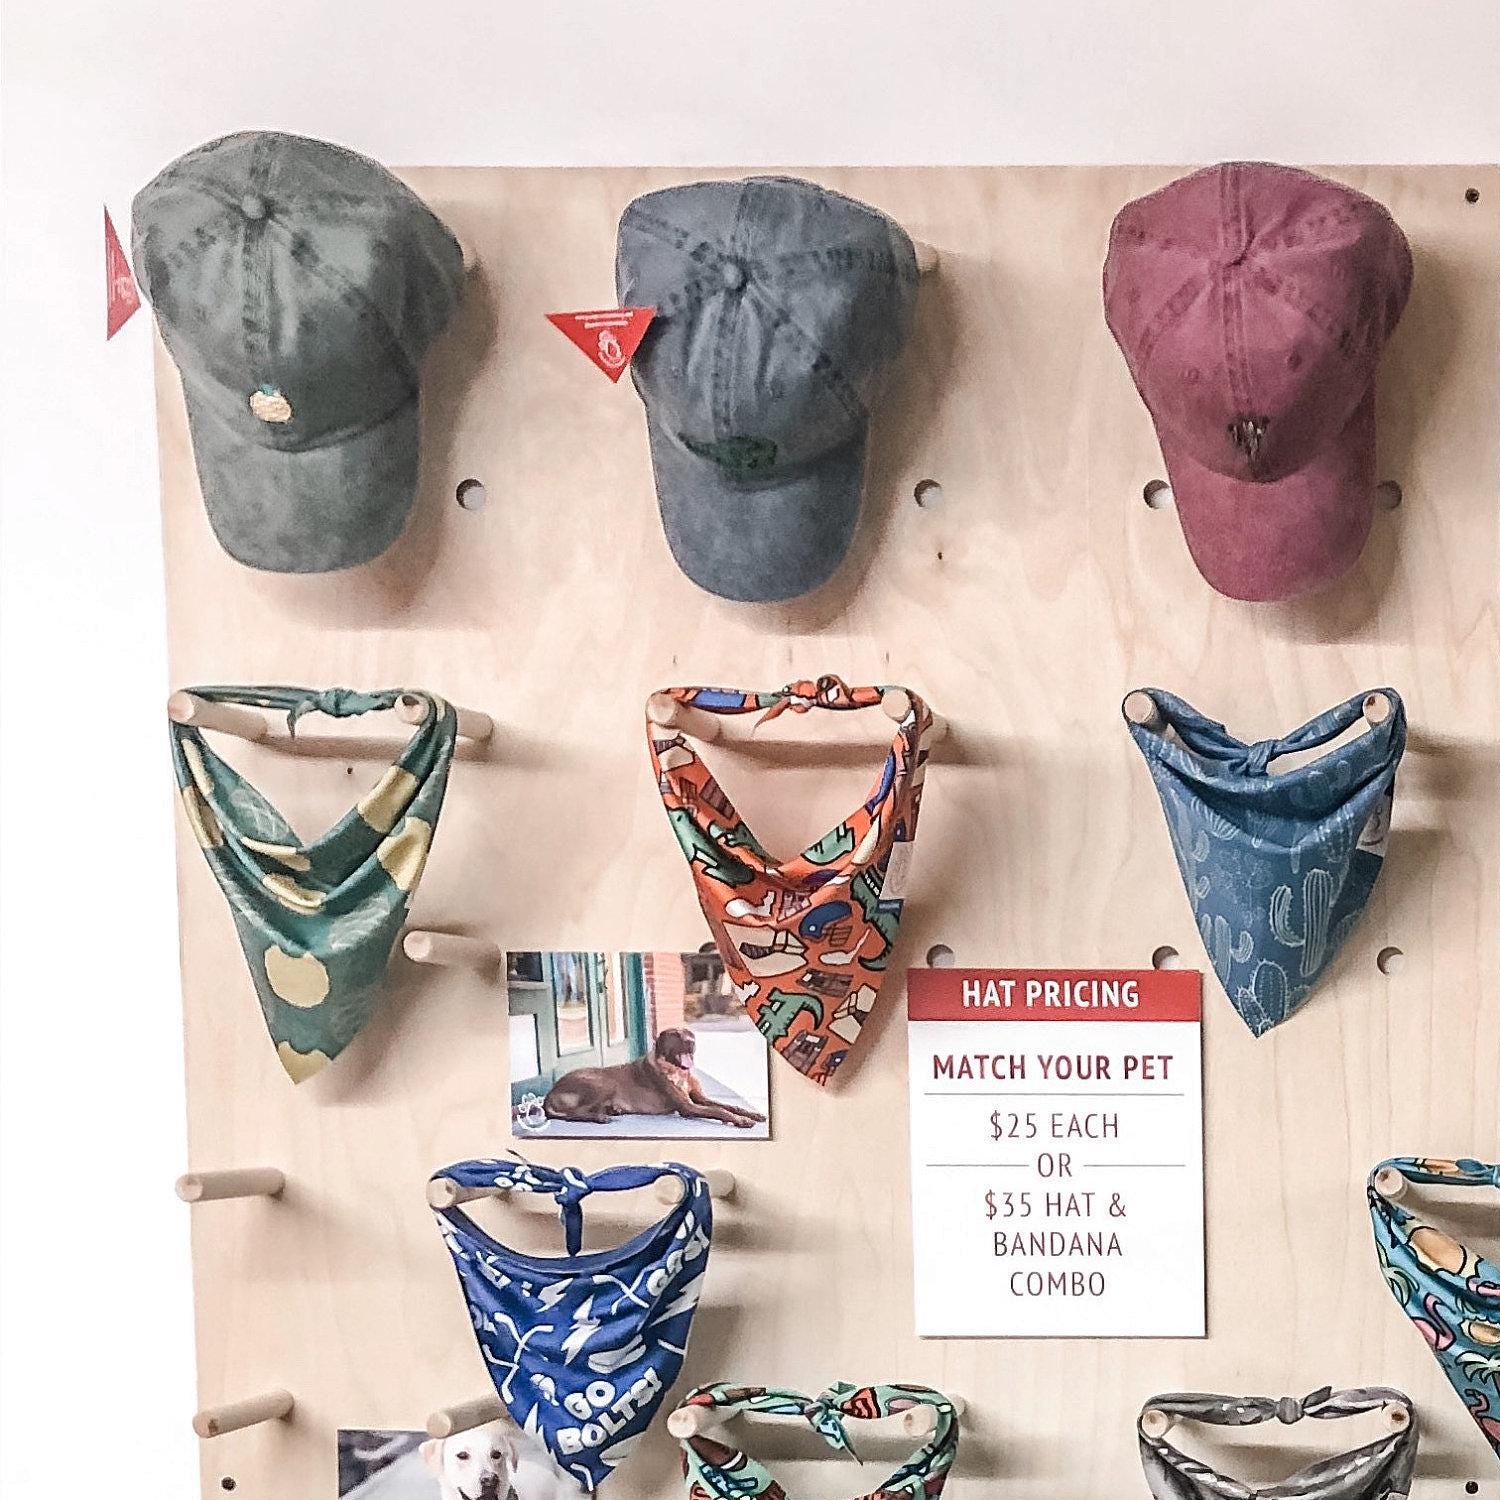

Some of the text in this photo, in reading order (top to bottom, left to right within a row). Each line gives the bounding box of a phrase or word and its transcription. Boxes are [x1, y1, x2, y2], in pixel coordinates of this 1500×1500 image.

[961, 979, 1140, 1009] HAT PRICING
[933, 1054, 1173, 1080] MATCH YOUR PET
[989, 1109, 1119, 1141] $25 EACH
[1037, 1152, 1072, 1178] OR
[984, 1189, 1127, 1220] $35 HAT &
[993, 1231, 1123, 1257] BANDANA
[1010, 1271, 1106, 1297] COMBO
[563, 1380, 616, 1421] GO
